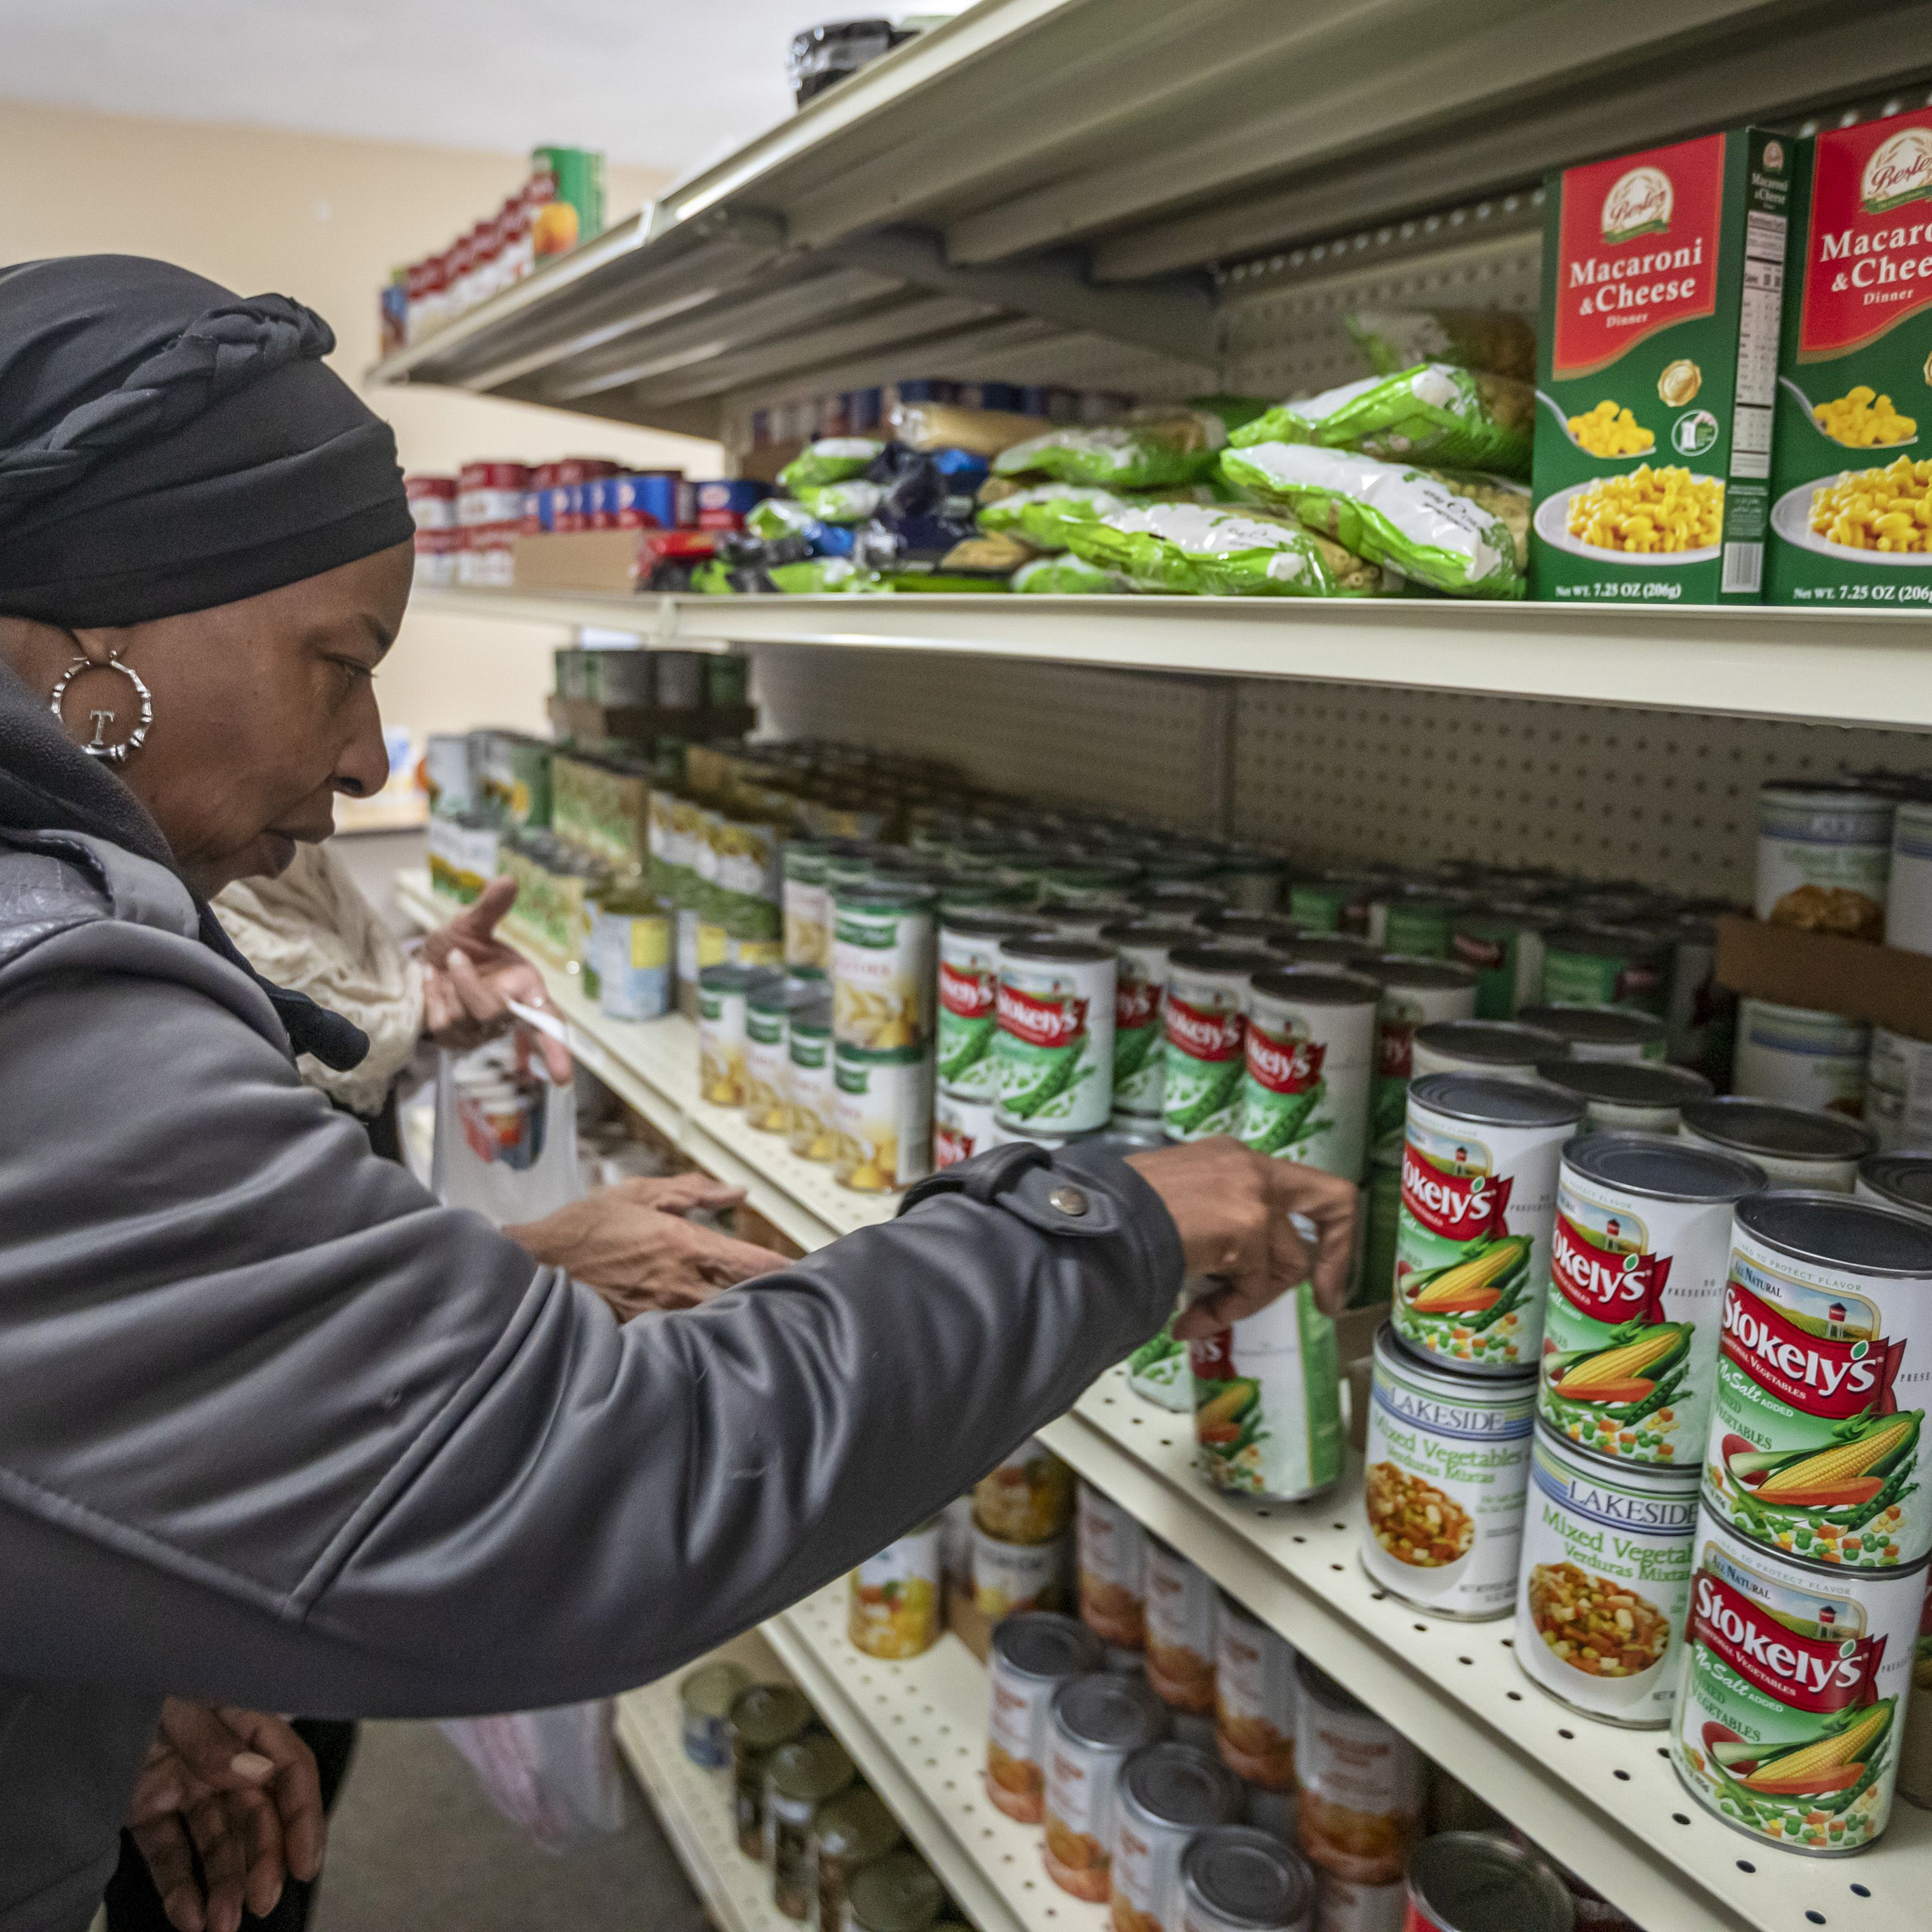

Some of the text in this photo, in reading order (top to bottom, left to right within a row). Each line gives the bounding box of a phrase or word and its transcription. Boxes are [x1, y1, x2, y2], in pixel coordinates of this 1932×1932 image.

[1569, 238, 1702, 288] Macaroni
[1863, 290, 1913, 305] Dinner
[1606, 314, 1648, 328] Dinner
[1593, 583, 1618, 596] 7.25
[1620, 583, 1642, 597] OZ
[1643, 583, 1681, 600] (206g)
[1839, 585, 1868, 600] 7.25
[1871, 585, 1896, 600] OZ
[1745, 1267, 1782, 1298] NATURAL
[1770, 1260, 1813, 1281] PROTECT
[1818, 1277, 1862, 1292] FLAVOR
[1388, 1385, 1504, 1430] LAKESIDE
[1729, 1372, 1761, 1403] Salt
[1759, 1398, 1794, 1417] ADDED
[1423, 1438, 1522, 1473] Vegetables
[1568, 1480, 1698, 1525] LAKESIDE
[1542, 1504, 1604, 1553] Mixed
[1564, 1541, 1634, 1577] Verduras
[1727, 1565, 1771, 1600] NATURAL
[1808, 1582, 1851, 1595] FLAVOR
[1710, 1663, 1749, 1697] Salt
[1748, 1693, 1784, 1713] ADDED
